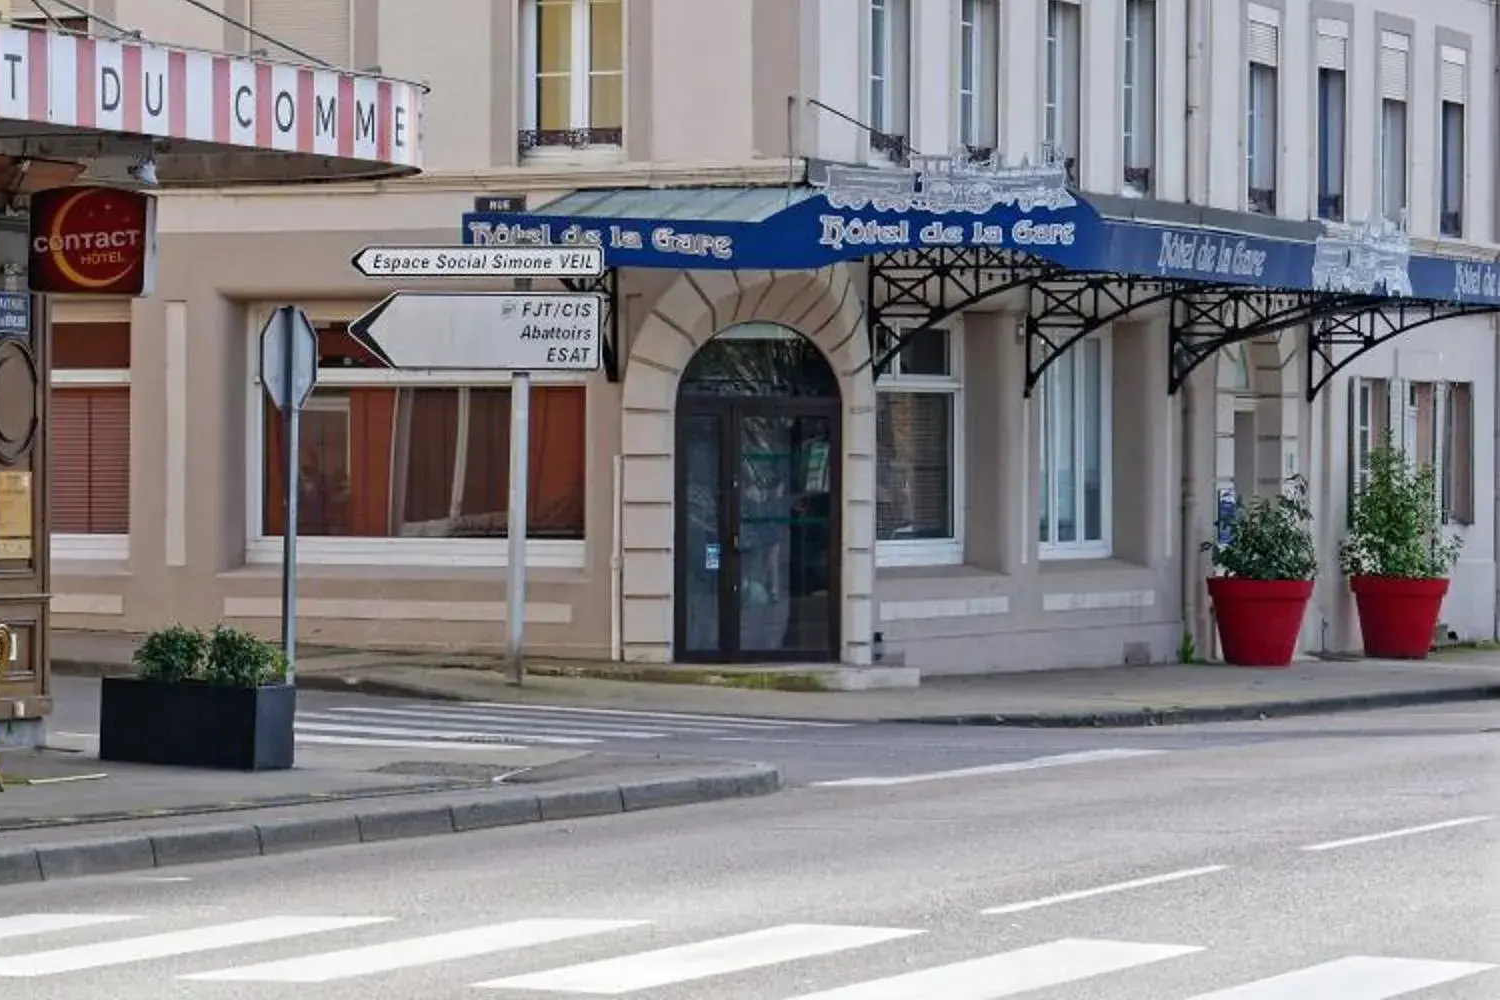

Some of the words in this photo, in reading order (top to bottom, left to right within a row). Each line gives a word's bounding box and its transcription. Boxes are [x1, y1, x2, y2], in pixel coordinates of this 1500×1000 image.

[101, 66, 164, 117] DU
[234, 84, 406, 149] COMME
[919, 221, 963, 244] de
[972, 221, 1003, 244] la
[609, 225, 643, 249] la
[651, 227, 733, 260] Gare
[373, 254, 429, 272] Espace
[435, 254, 487, 269] Social
[491, 254, 552, 269] Simone
[559, 253, 594, 269] VEIL
[522, 302, 591, 317] FJT/CIS
[520, 325, 591, 340] Abattoirs
[547, 347, 591, 362] ESAT
